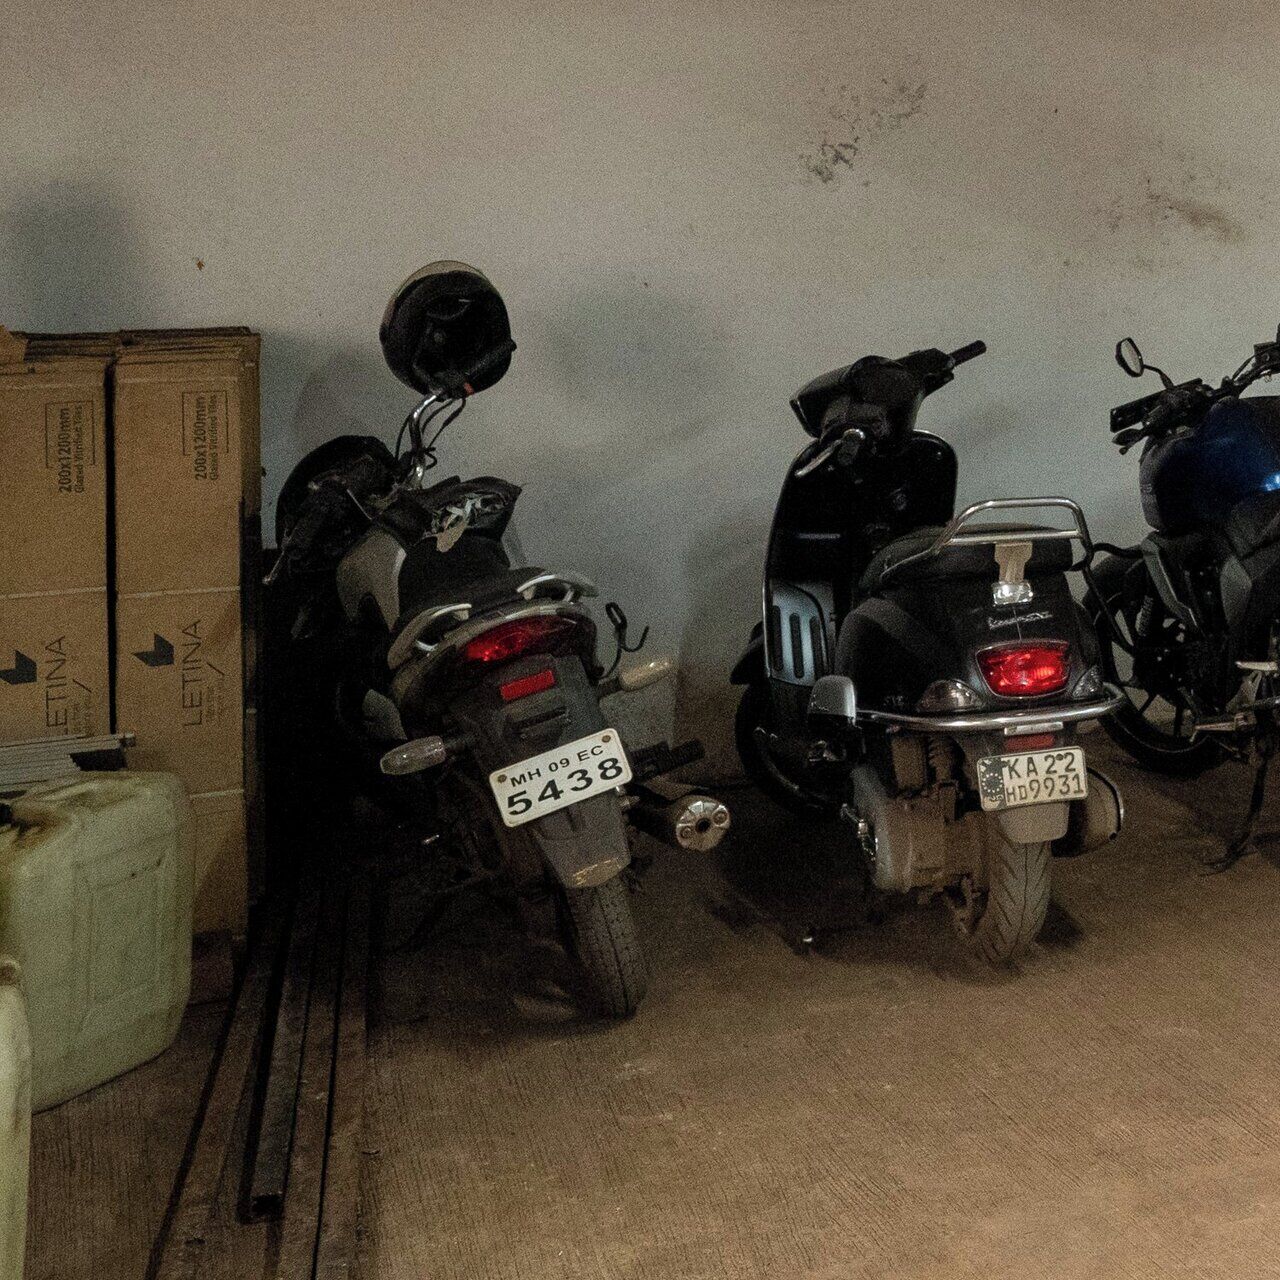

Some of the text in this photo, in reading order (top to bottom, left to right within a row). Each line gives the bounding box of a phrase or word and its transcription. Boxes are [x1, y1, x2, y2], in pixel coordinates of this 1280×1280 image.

[58, 407, 72, 493] 200x1200mm
[193, 396, 207, 481] 200x1200mm
[181, 619, 203, 728] LETINA
[506, 757, 623, 816] 5438
[510, 744, 604, 788] MH 09 EC
